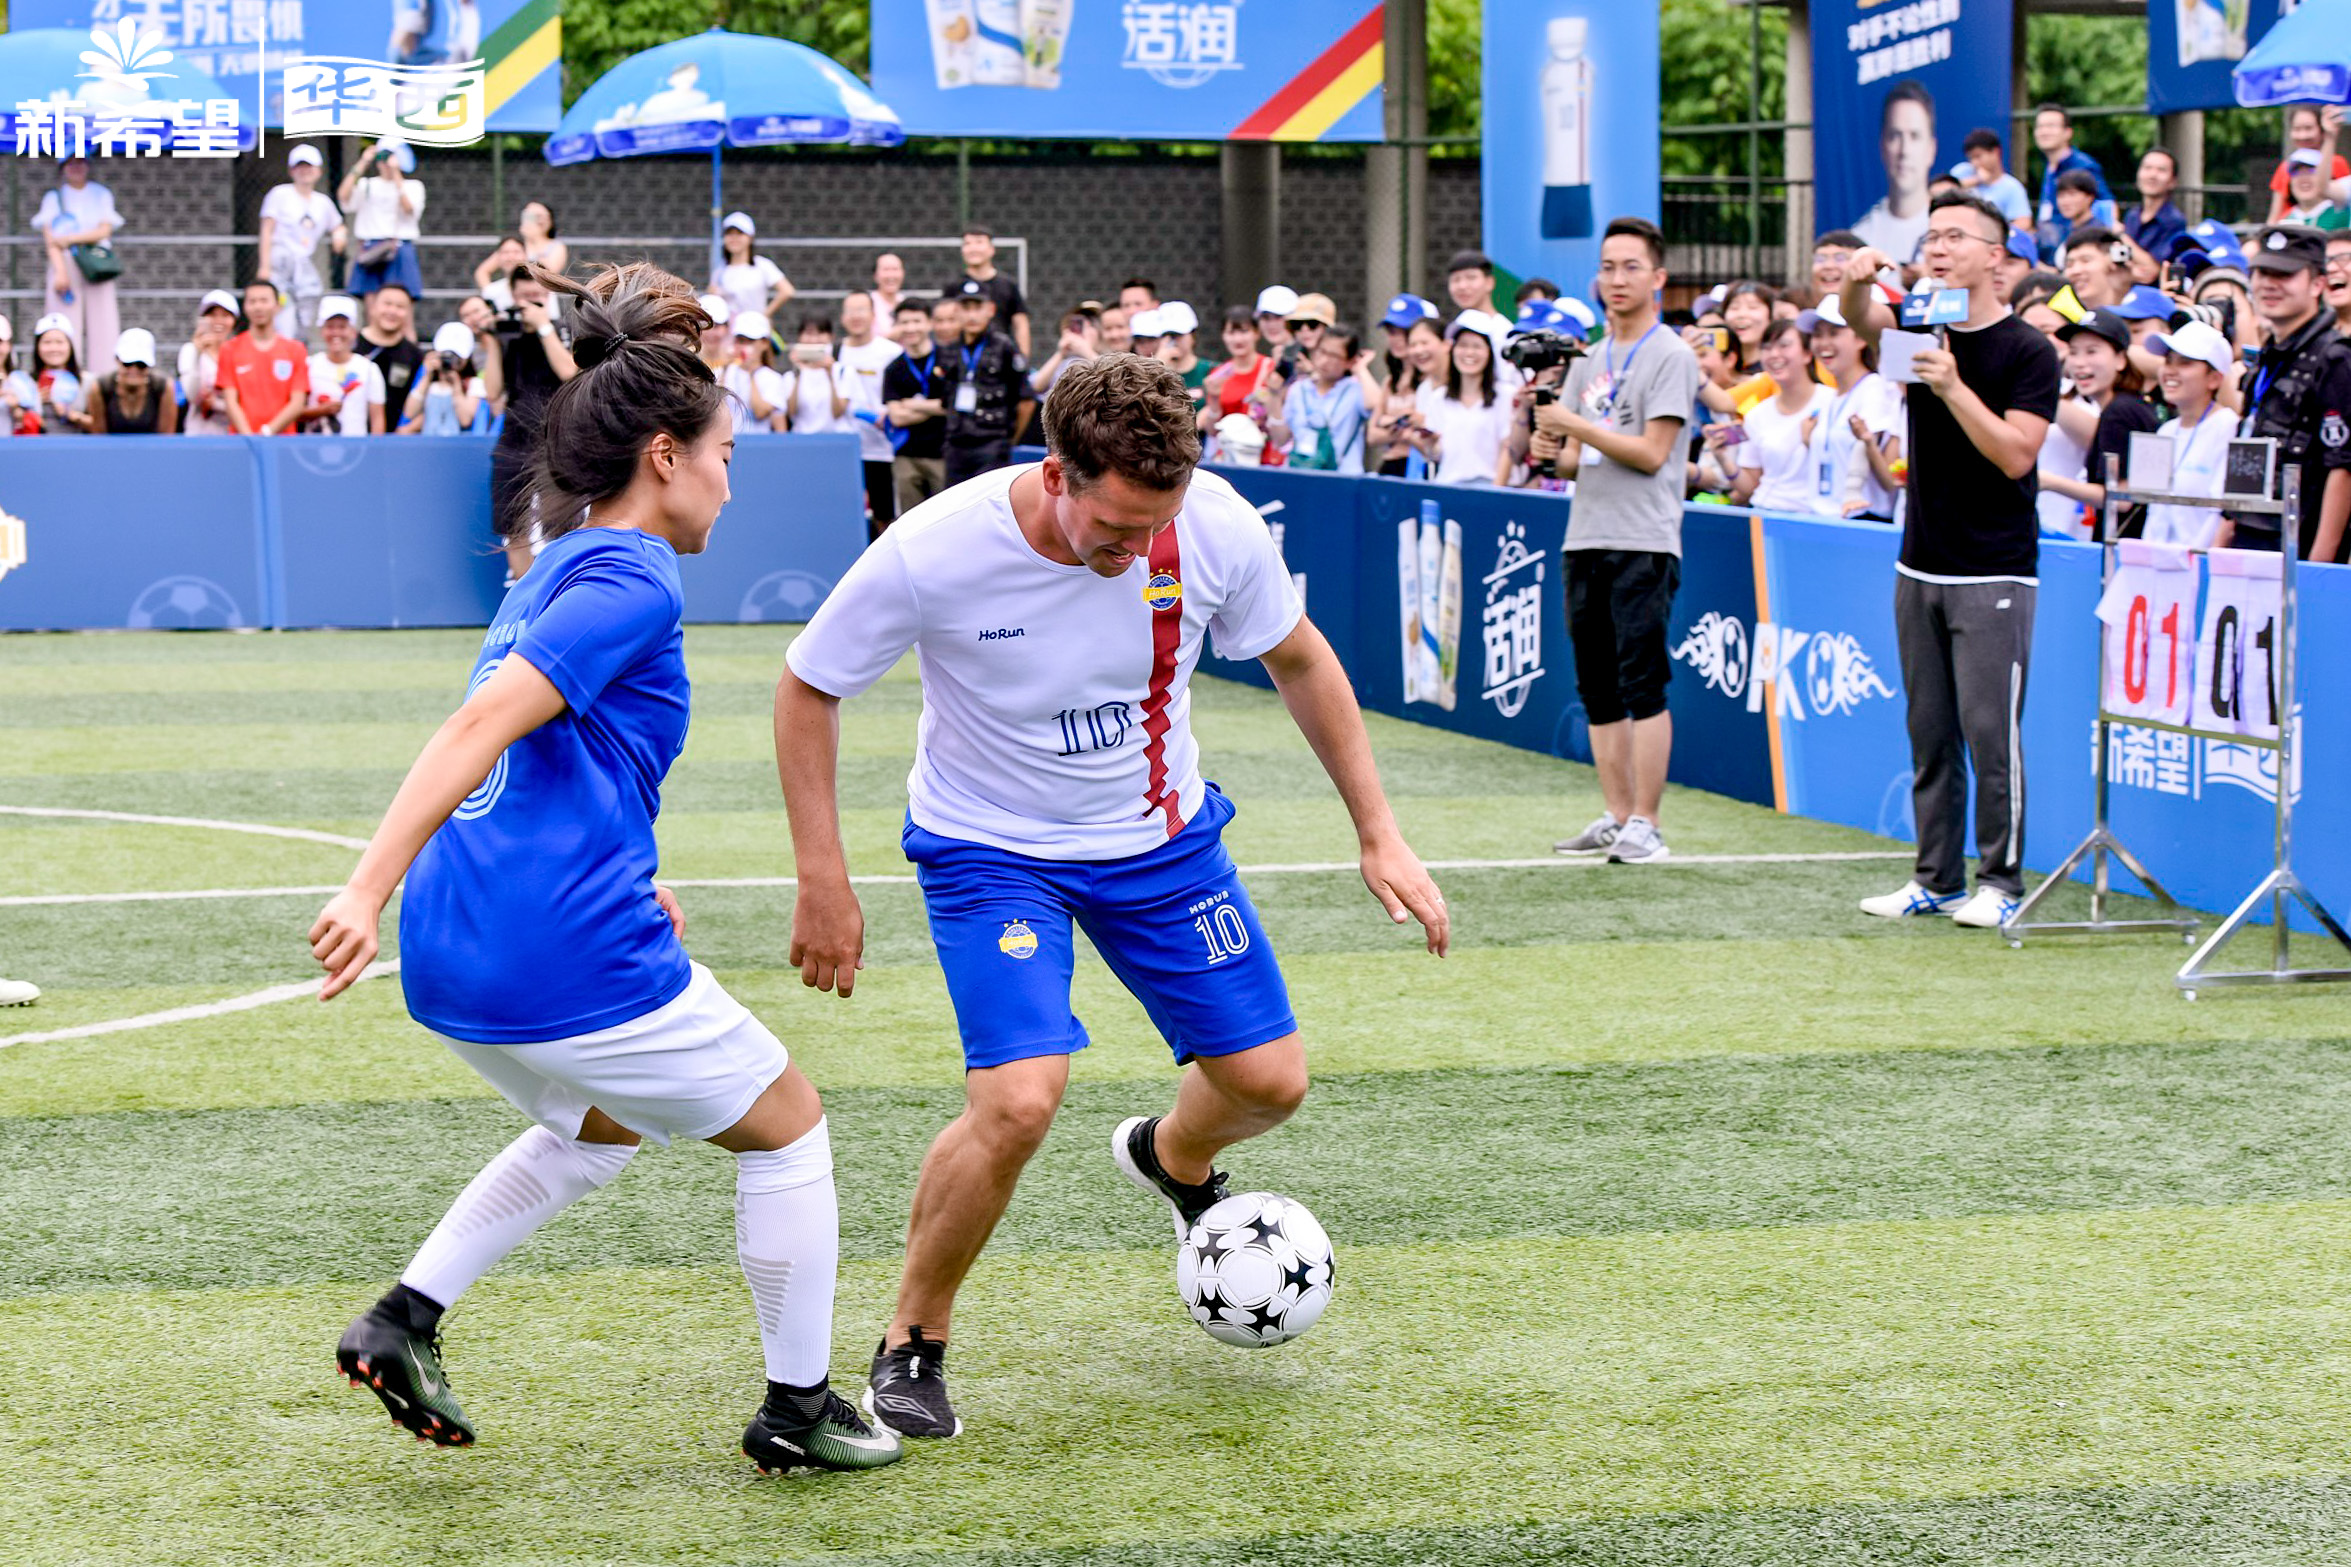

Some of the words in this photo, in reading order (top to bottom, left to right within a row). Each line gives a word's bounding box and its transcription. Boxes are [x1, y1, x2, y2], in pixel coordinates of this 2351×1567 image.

[1122, 2, 1238, 62] 活润
[978, 627, 1026, 642] HoRun
[1051, 701, 1133, 757] 10
[1194, 904, 1250, 966] 10
